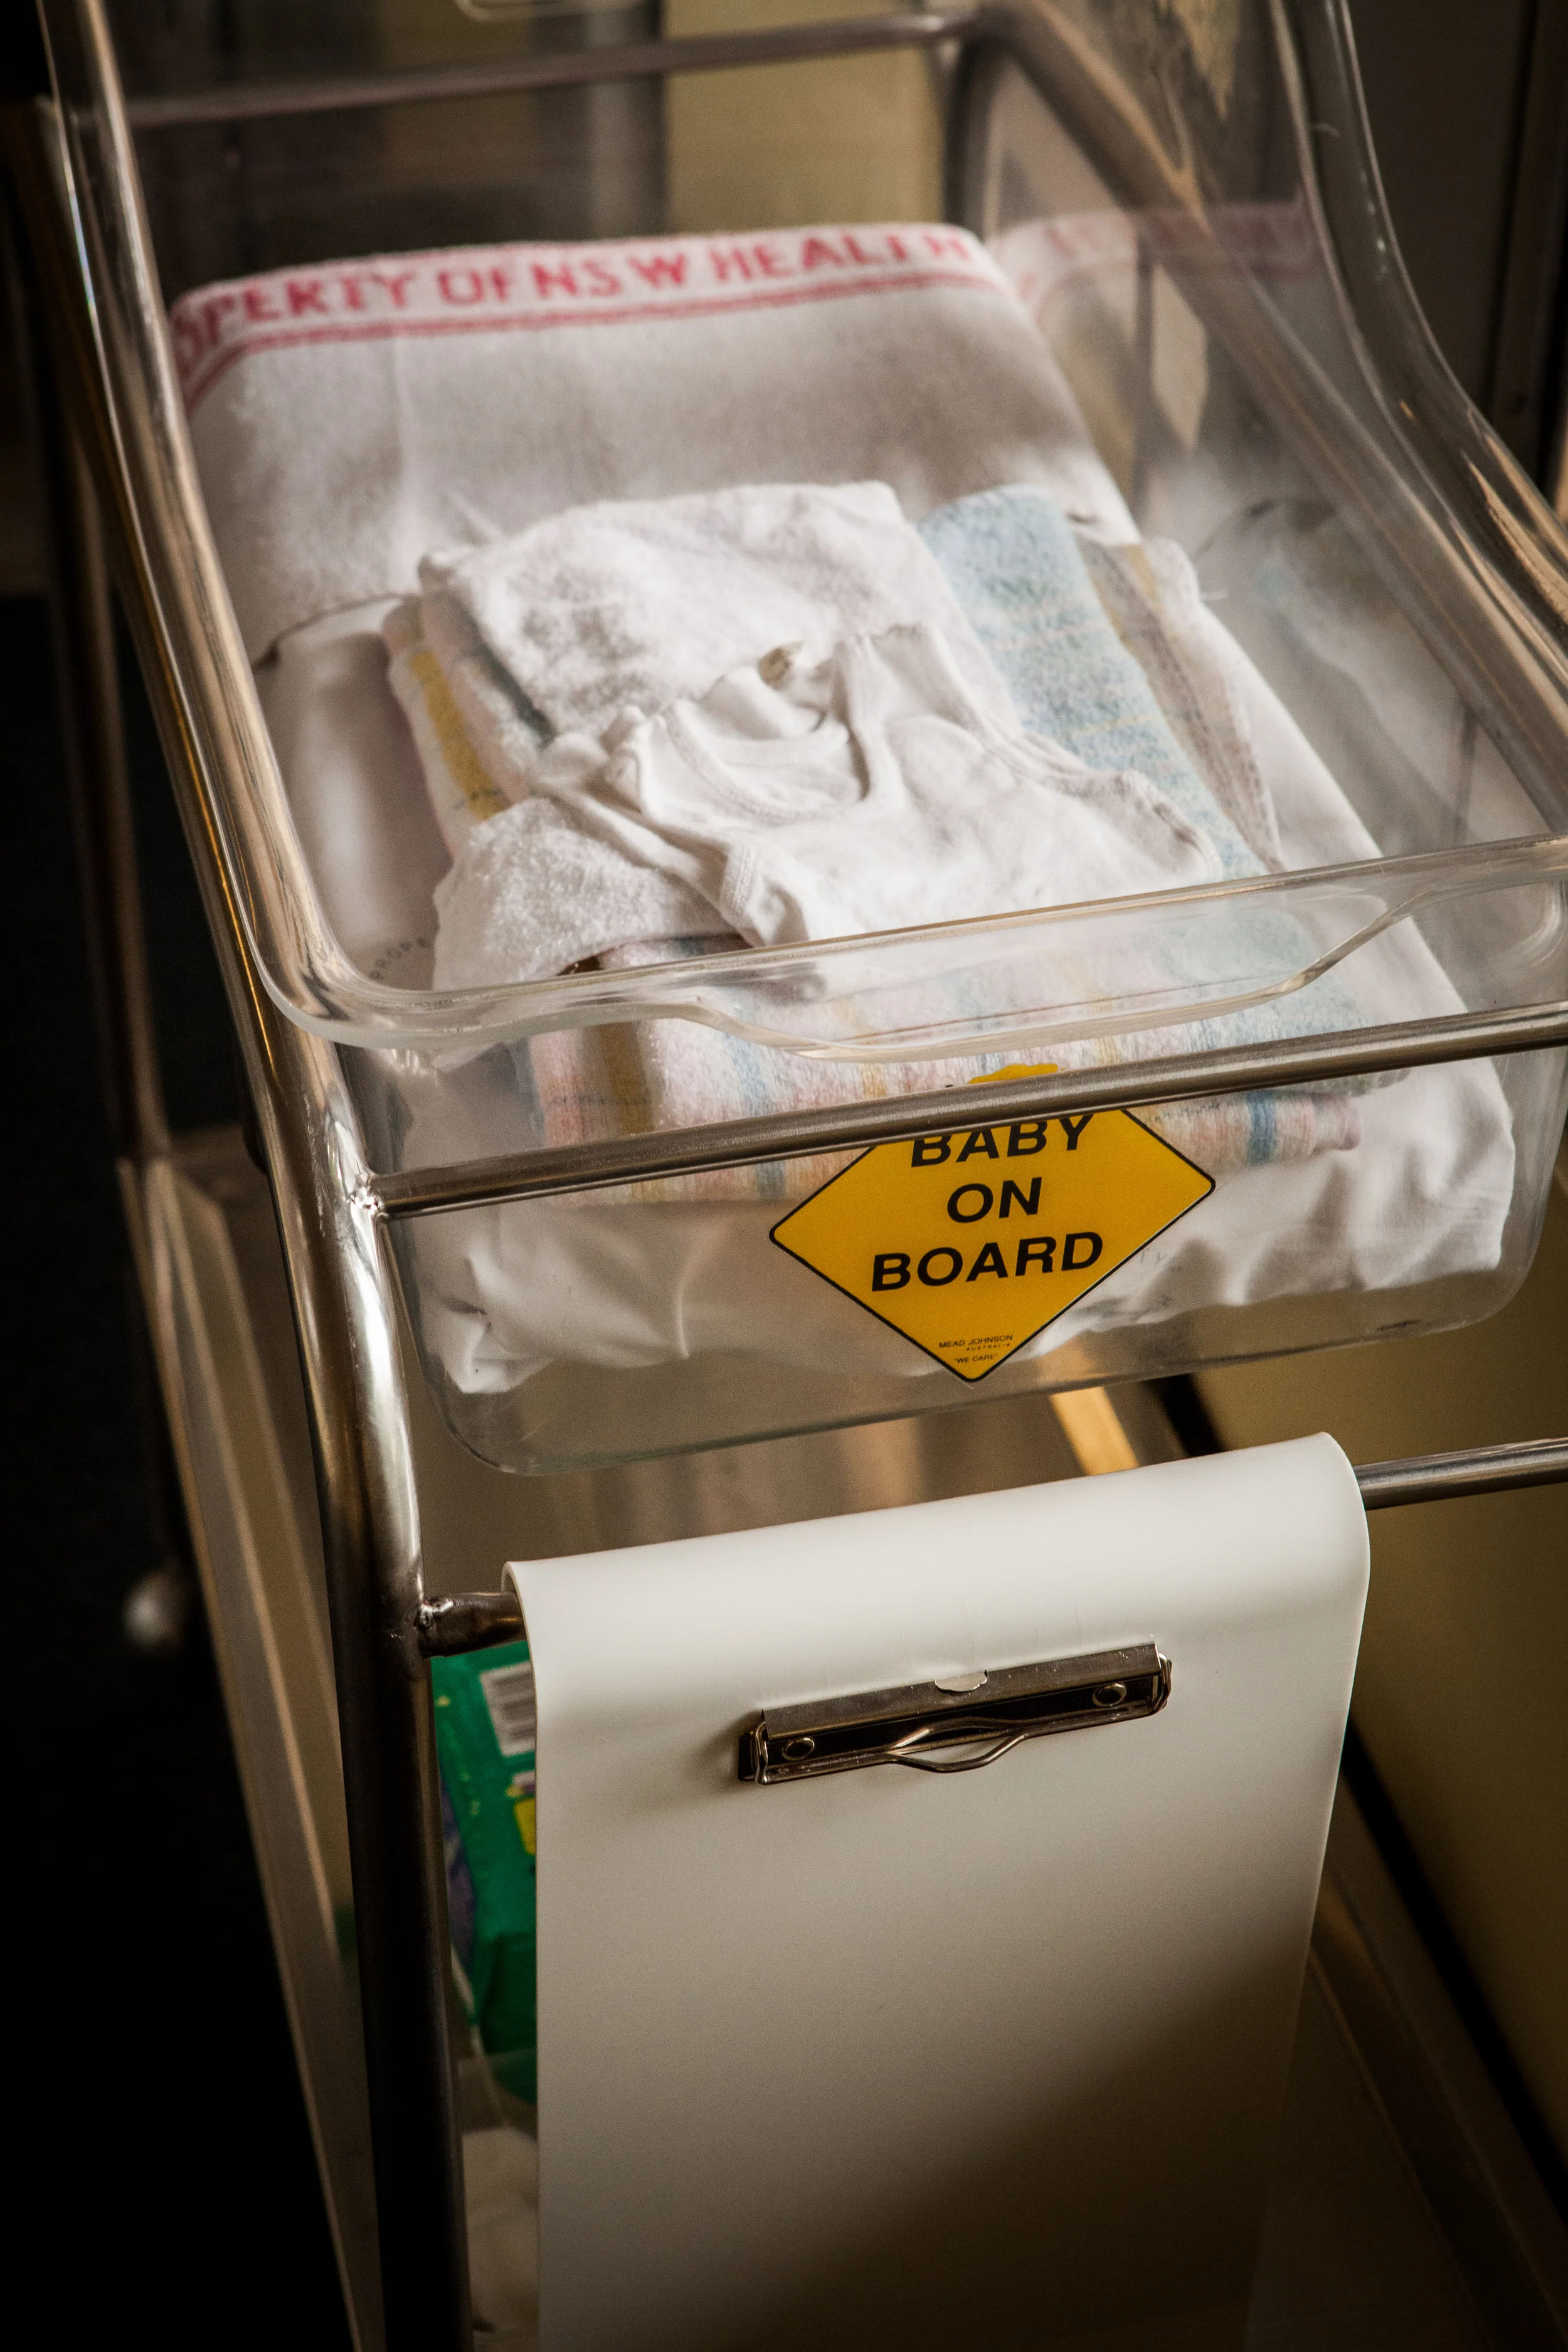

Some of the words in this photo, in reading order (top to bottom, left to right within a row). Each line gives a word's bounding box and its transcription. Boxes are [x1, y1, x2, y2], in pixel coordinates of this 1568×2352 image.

[437, 266, 513, 306] OF
[530, 252, 688, 299] NSW
[708, 230, 970, 282] HEALTH
[911, 1114, 1094, 1168] BABY
[946, 1177, 1042, 1223] ON
[871, 1231, 1103, 1292] BOARD
[939, 1338, 965, 1348] MEAD
[968, 1335, 1014, 1346] JOHNSON
